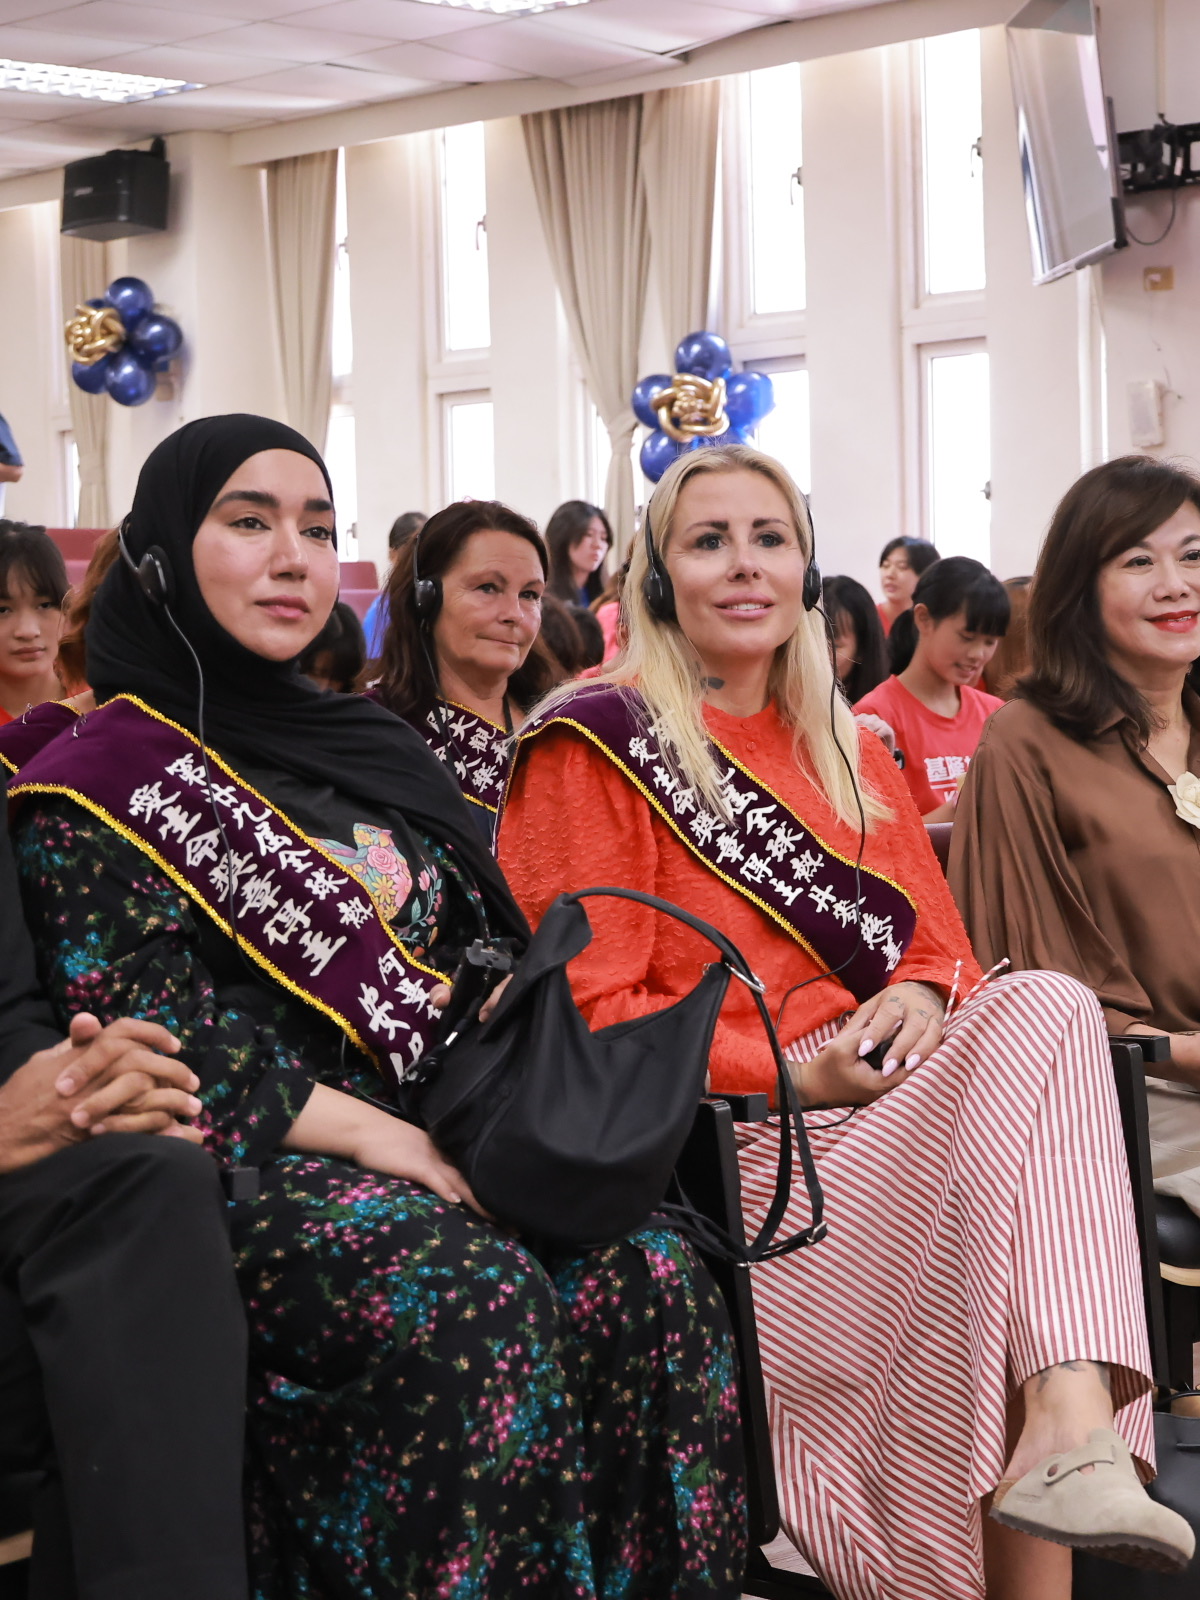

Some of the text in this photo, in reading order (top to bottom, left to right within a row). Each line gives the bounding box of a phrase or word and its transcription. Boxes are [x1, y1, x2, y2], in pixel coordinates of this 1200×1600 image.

[128, 780, 347, 977] 愛生命獎章得主
